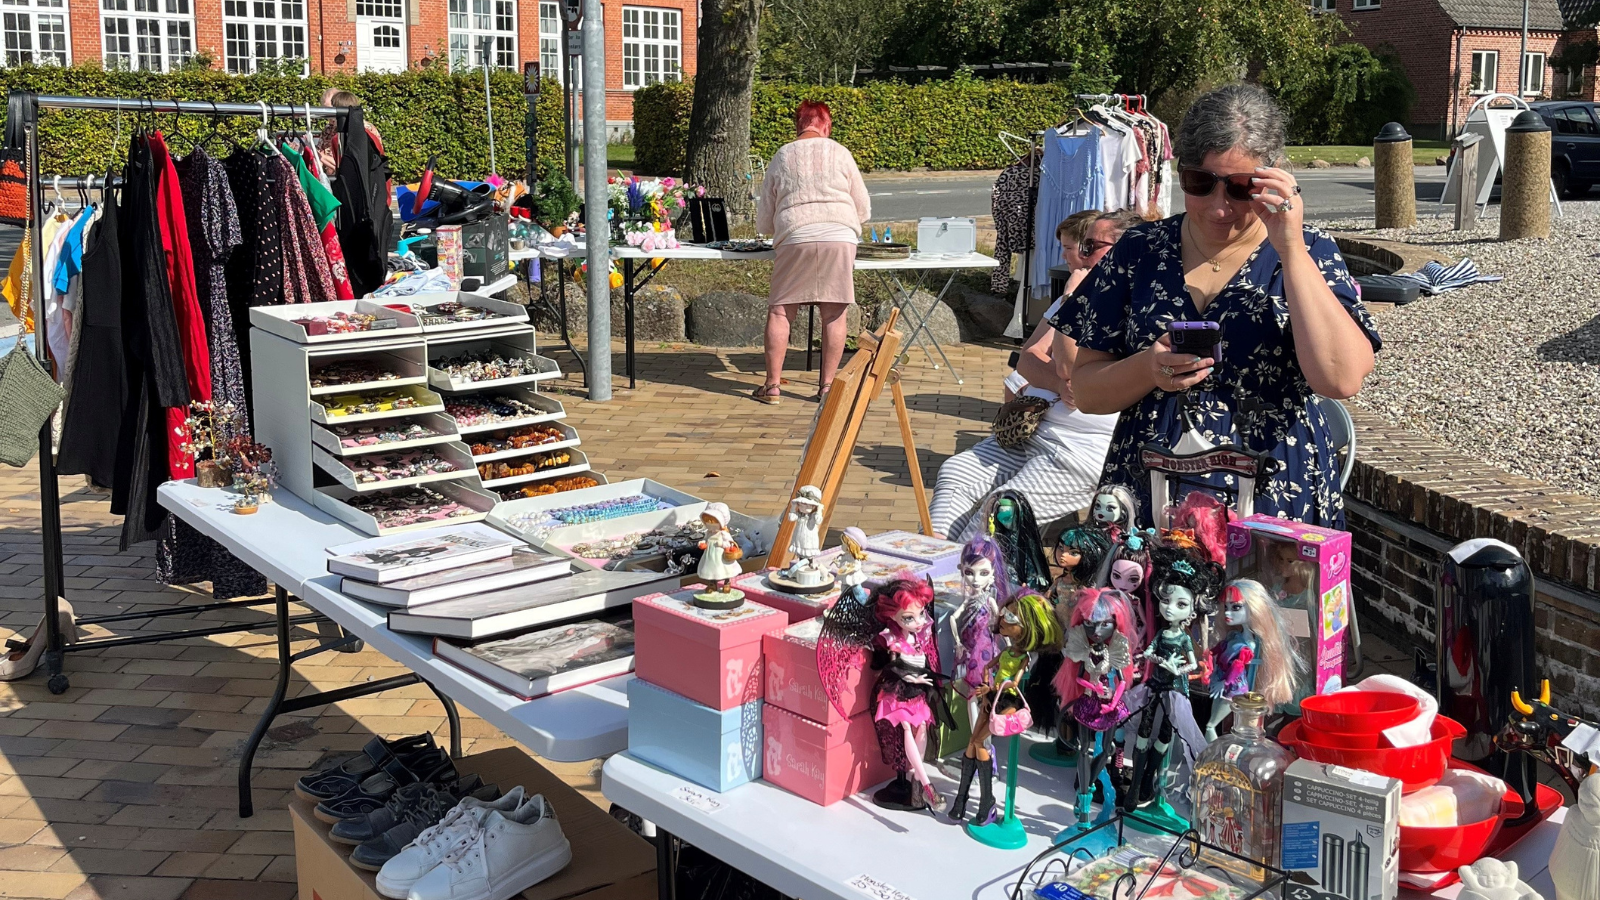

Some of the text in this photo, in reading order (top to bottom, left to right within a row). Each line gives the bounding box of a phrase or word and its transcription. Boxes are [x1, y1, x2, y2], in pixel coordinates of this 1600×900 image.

[1209, 454, 1238, 467] HIGH
[788, 677, 828, 712] Sarah Kay
[785, 753, 825, 790] Sarah Kay
[1306, 784, 1358, 801] CAPPUCCINO-SET
[1306, 790, 1358, 808] CAPPUCCINO-SET,
[1358, 802, 1379, 812] 4-part
[1305, 796, 1318, 804] SET
[1318, 800, 1356, 813] CAPPUCCINO
[1053, 883, 1069, 892] 40
